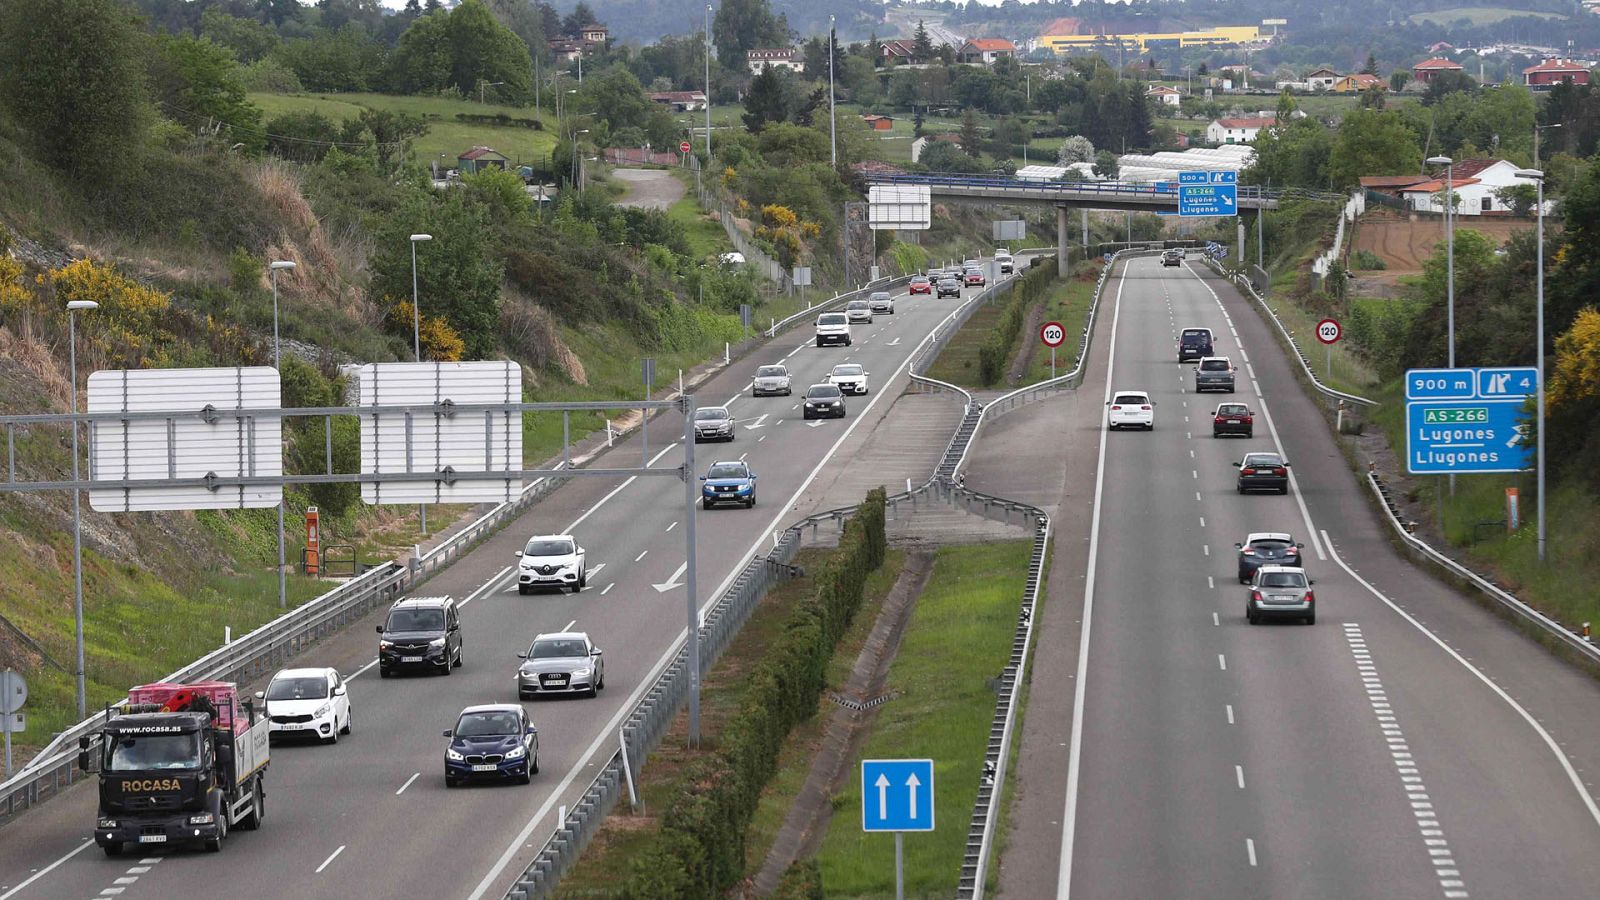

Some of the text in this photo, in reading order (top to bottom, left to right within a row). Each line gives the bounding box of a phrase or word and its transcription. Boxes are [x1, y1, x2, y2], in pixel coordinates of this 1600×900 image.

[1046, 330, 1060, 338] 120
[1415, 379, 1466, 390] 900 m
[1520, 378, 1530, 388] 4
[1426, 410, 1486, 421] AS-266
[1420, 428, 1495, 443] Lugones
[1416, 451, 1498, 466] Llugones
[122, 779, 180, 792] ROCASA
